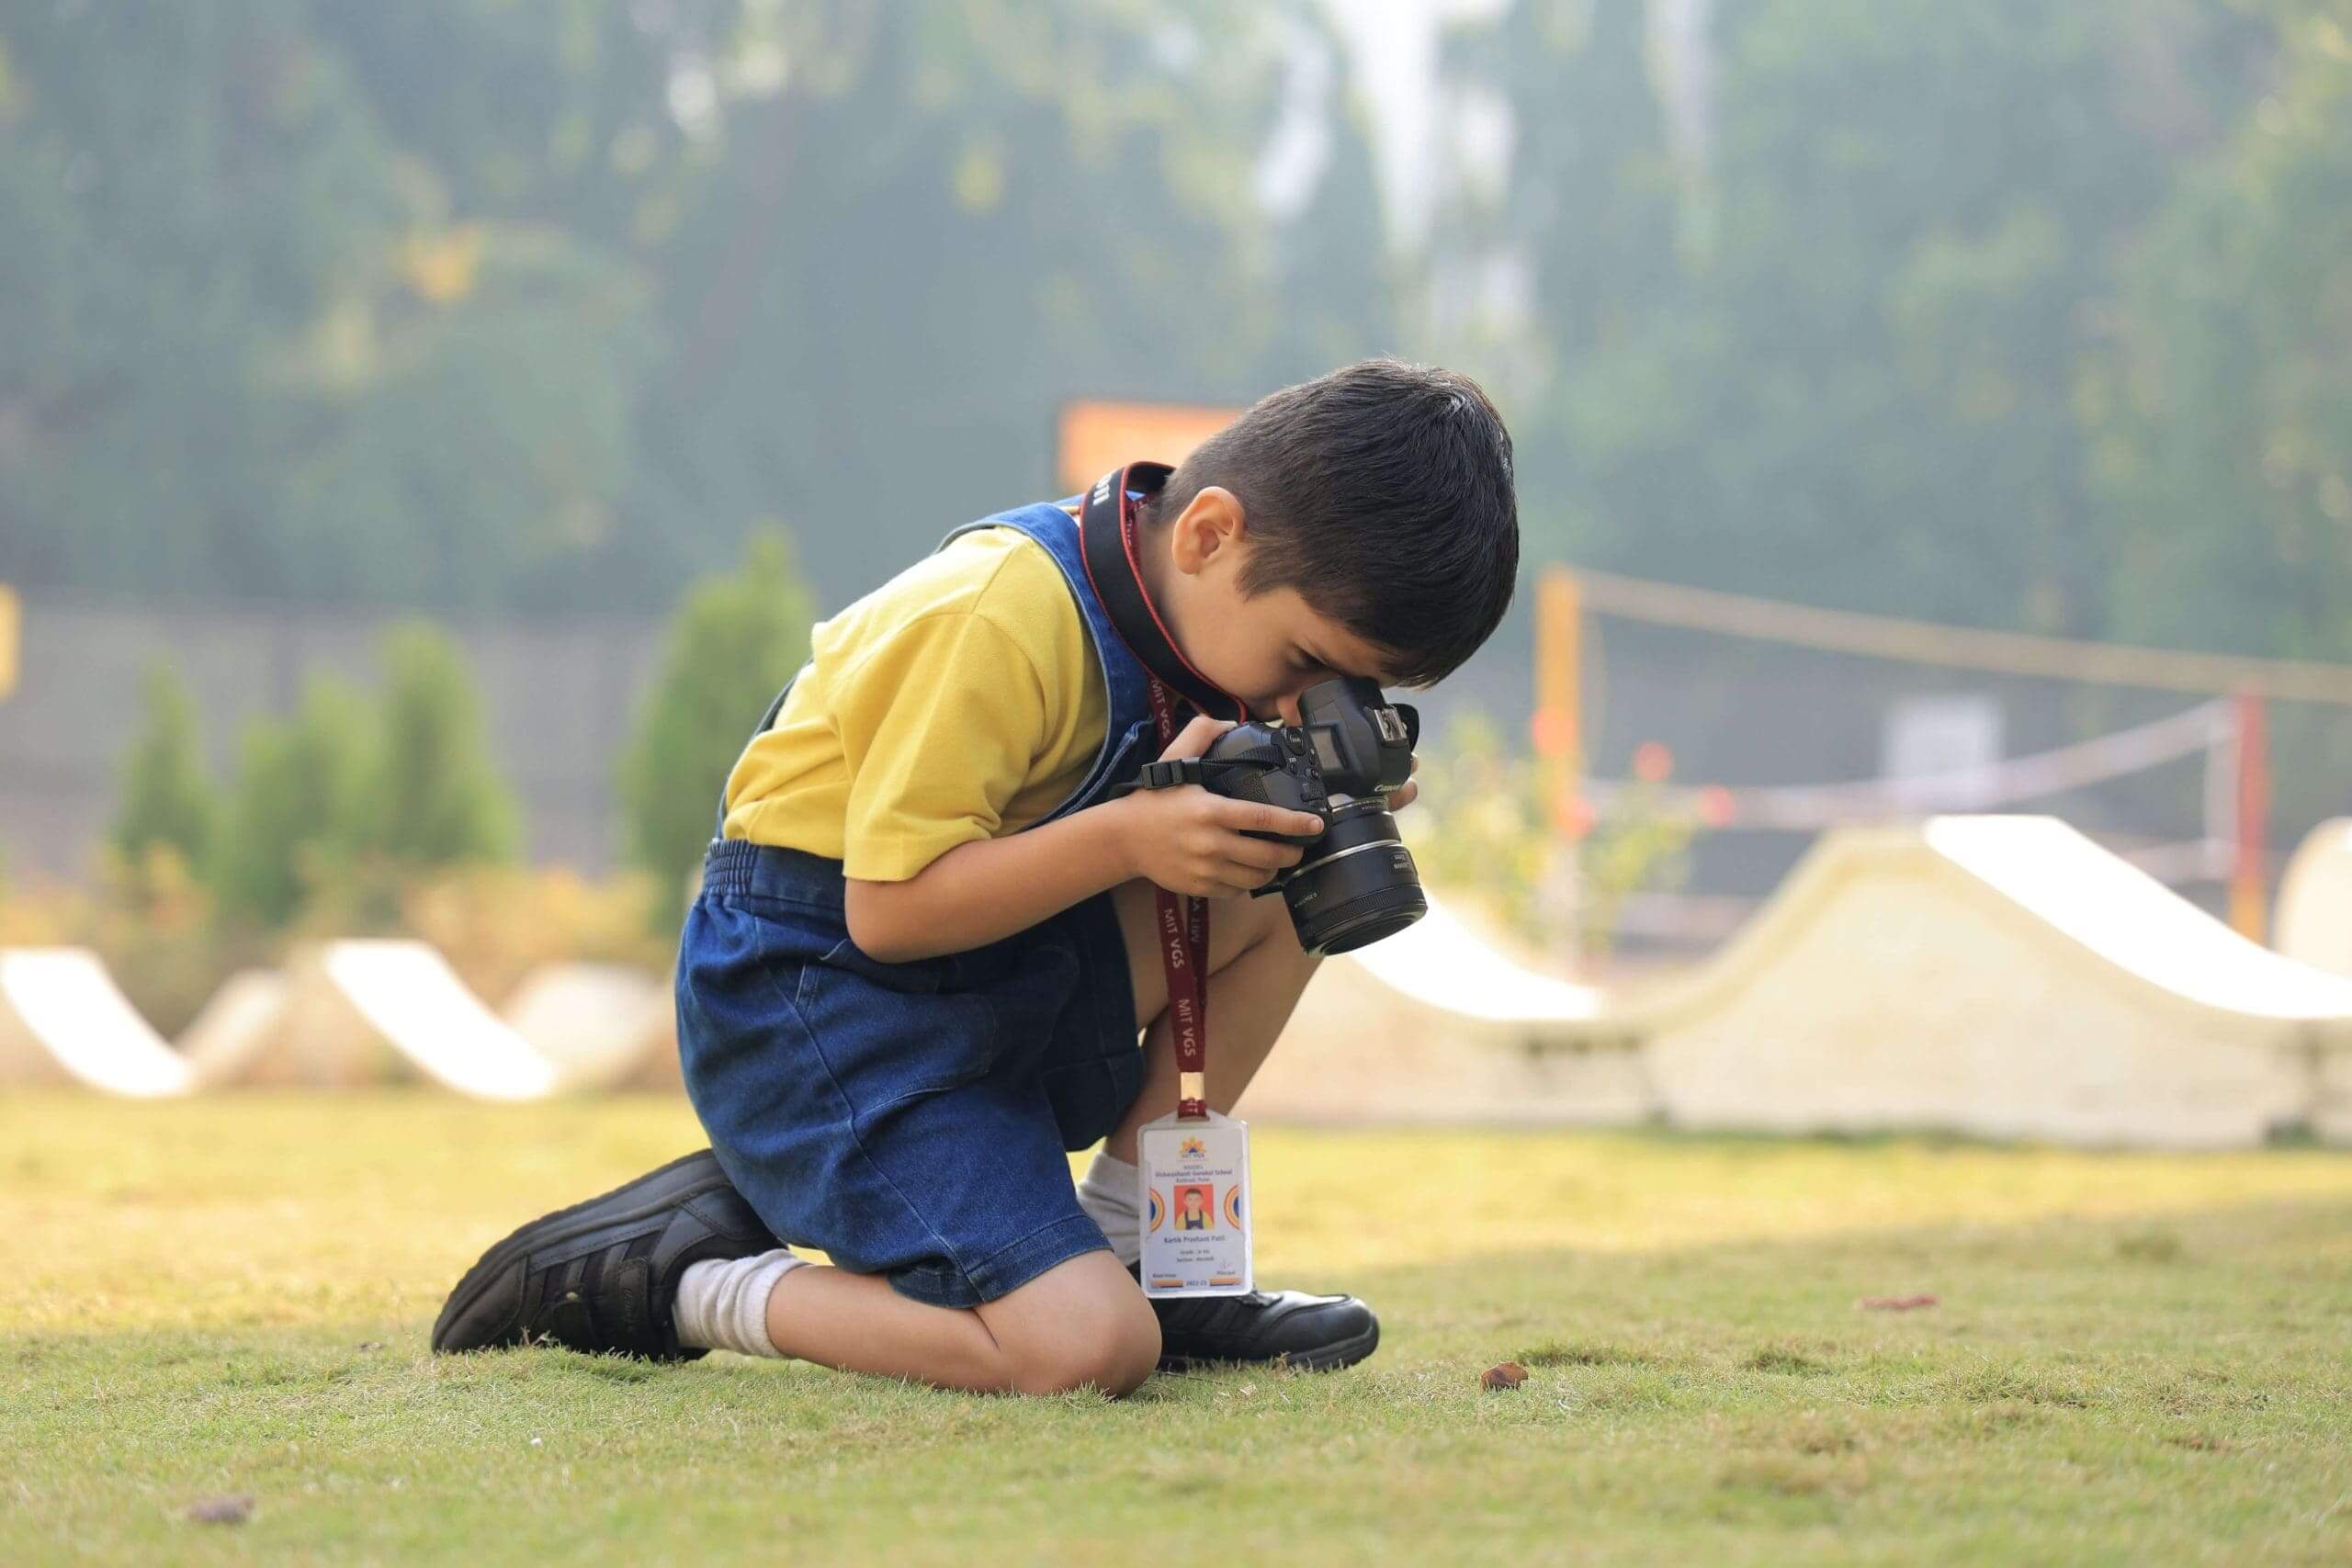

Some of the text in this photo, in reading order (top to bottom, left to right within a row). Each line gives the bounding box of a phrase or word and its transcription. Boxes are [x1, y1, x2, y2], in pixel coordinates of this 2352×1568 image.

[1150, 677, 1170, 739] MIT VGS
[1164, 908, 1185, 968] MIT VGS
[1178, 998, 1196, 1057] MIT VGS
